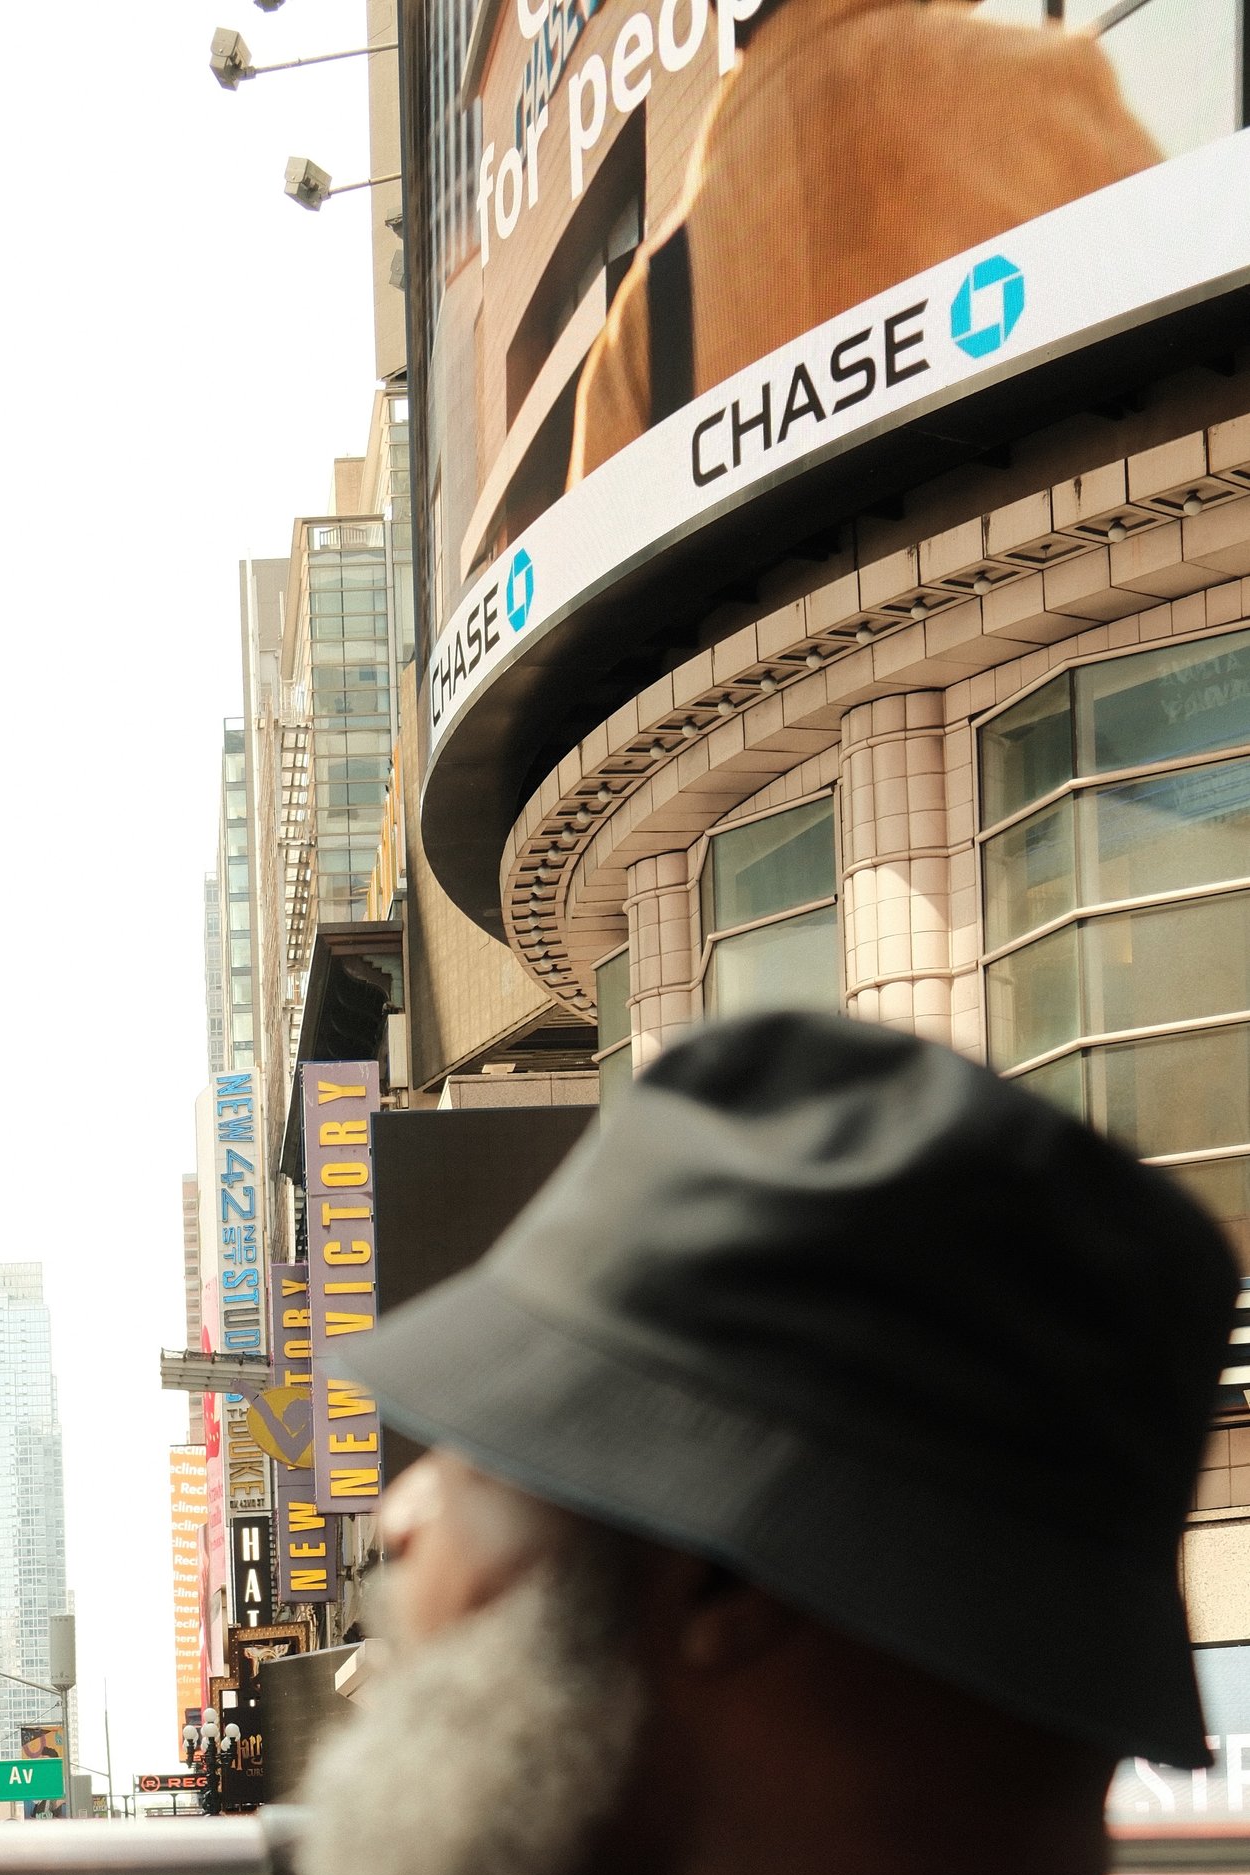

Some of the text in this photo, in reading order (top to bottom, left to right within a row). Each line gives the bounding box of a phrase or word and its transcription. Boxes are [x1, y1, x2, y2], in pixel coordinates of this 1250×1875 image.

[476, 103, 548, 269] for
[691, 298, 932, 488] CHASE
[431, 582, 501, 728] CHASE
[216, 1073, 254, 1142] NEW
[220, 1148, 255, 1222] 42
[222, 1268, 261, 1403] STUD
[317, 1079, 380, 1498] NEW VICTORY
[228, 1420, 266, 1498] DUKE
[288, 1502, 328, 1591] NEW
